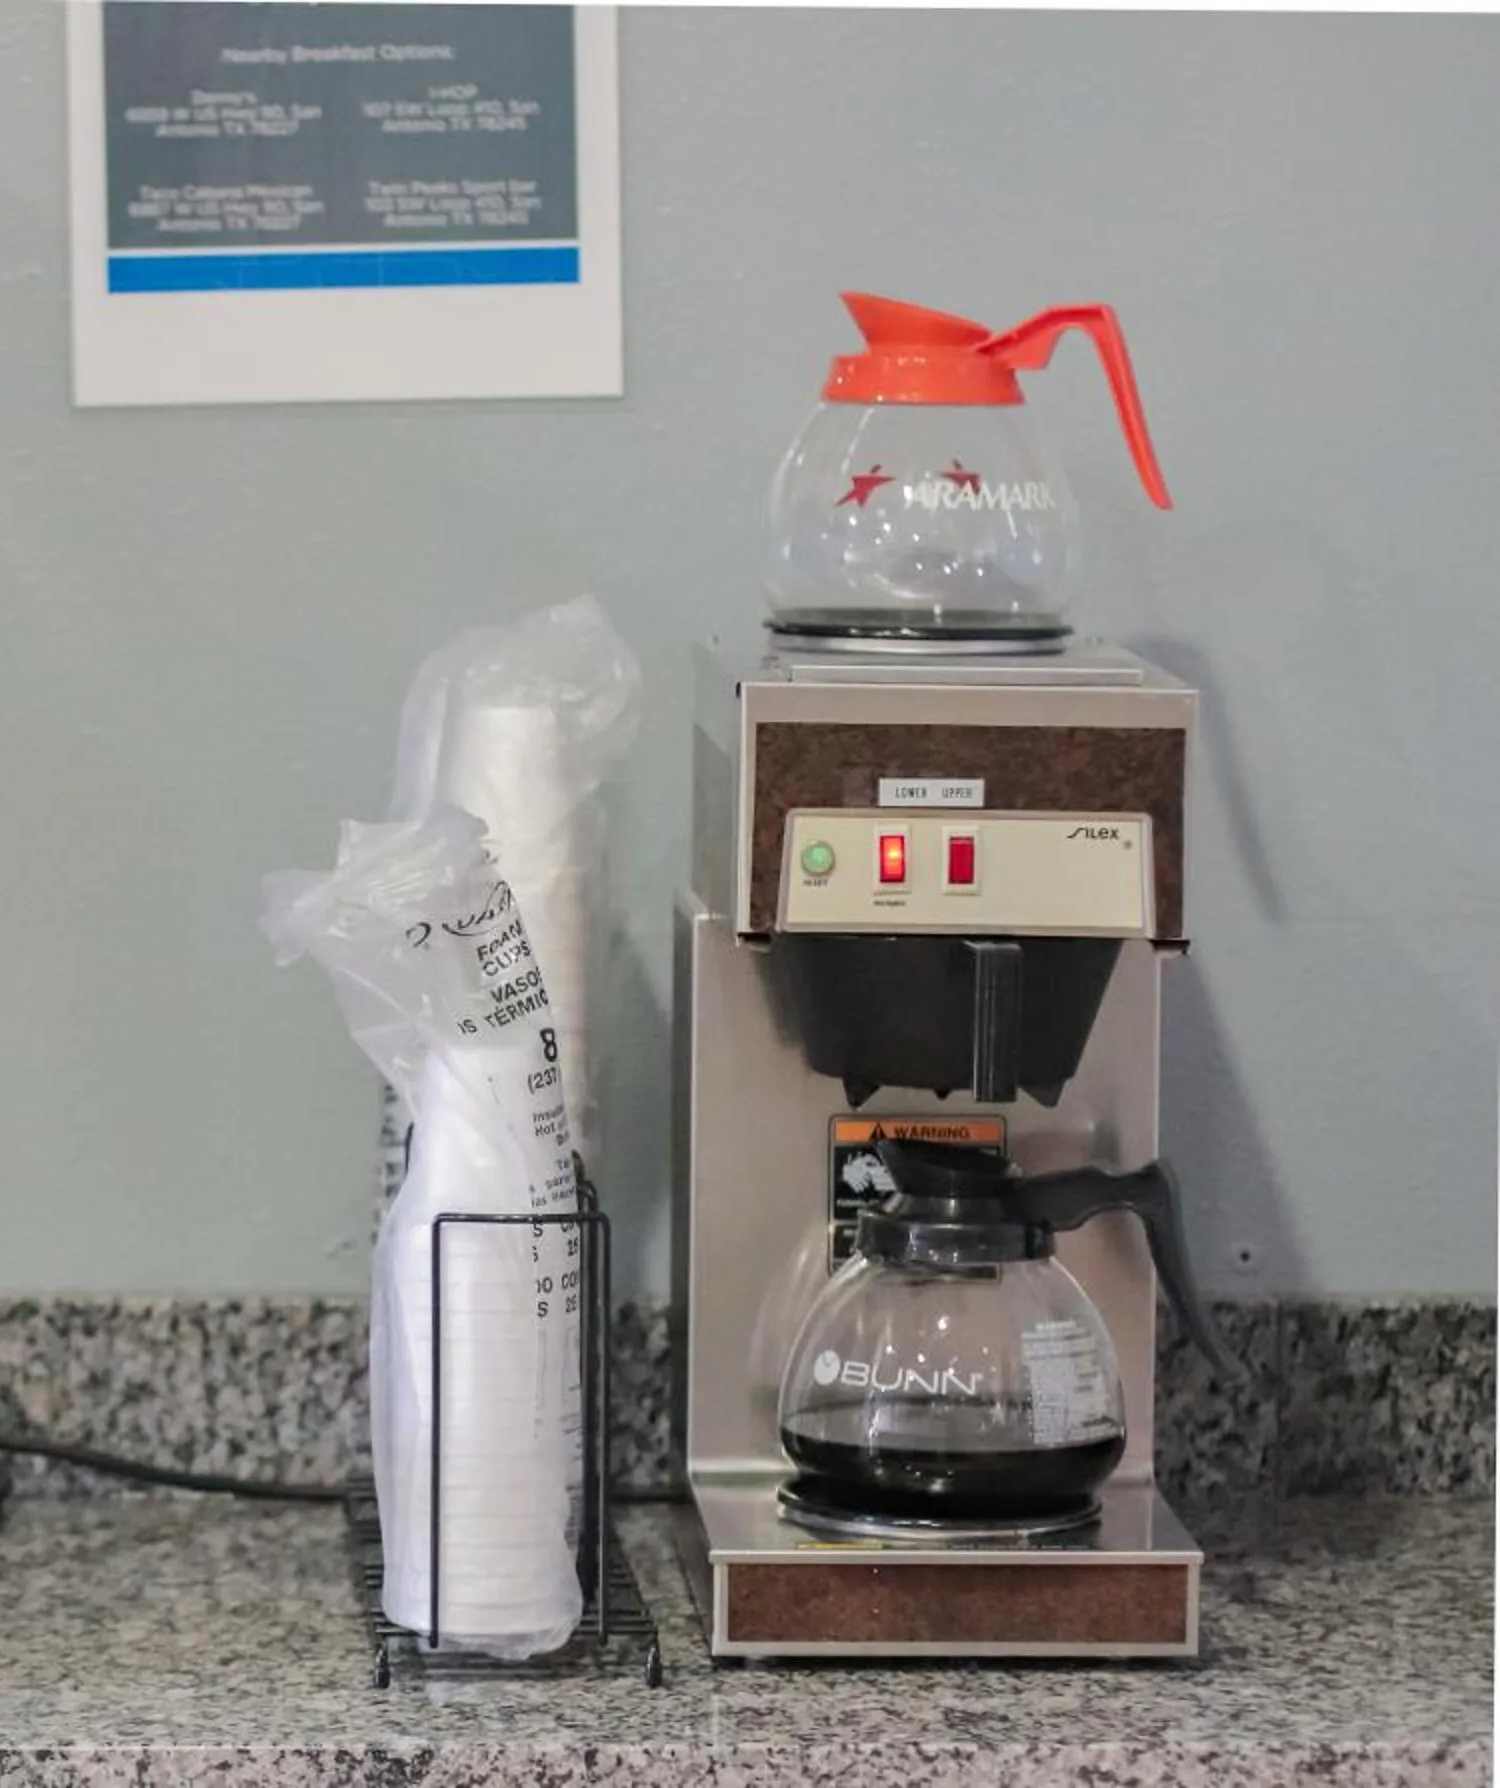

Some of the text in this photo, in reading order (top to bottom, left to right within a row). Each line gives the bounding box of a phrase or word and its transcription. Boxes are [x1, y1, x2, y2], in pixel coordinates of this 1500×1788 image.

[912, 479, 1057, 511] ARAMARK
[894, 786, 927, 799] LOWER
[539, 1027, 558, 1062] 8
[893, 1126, 970, 1140] WARNING
[841, 1361, 976, 1395] BUNN
